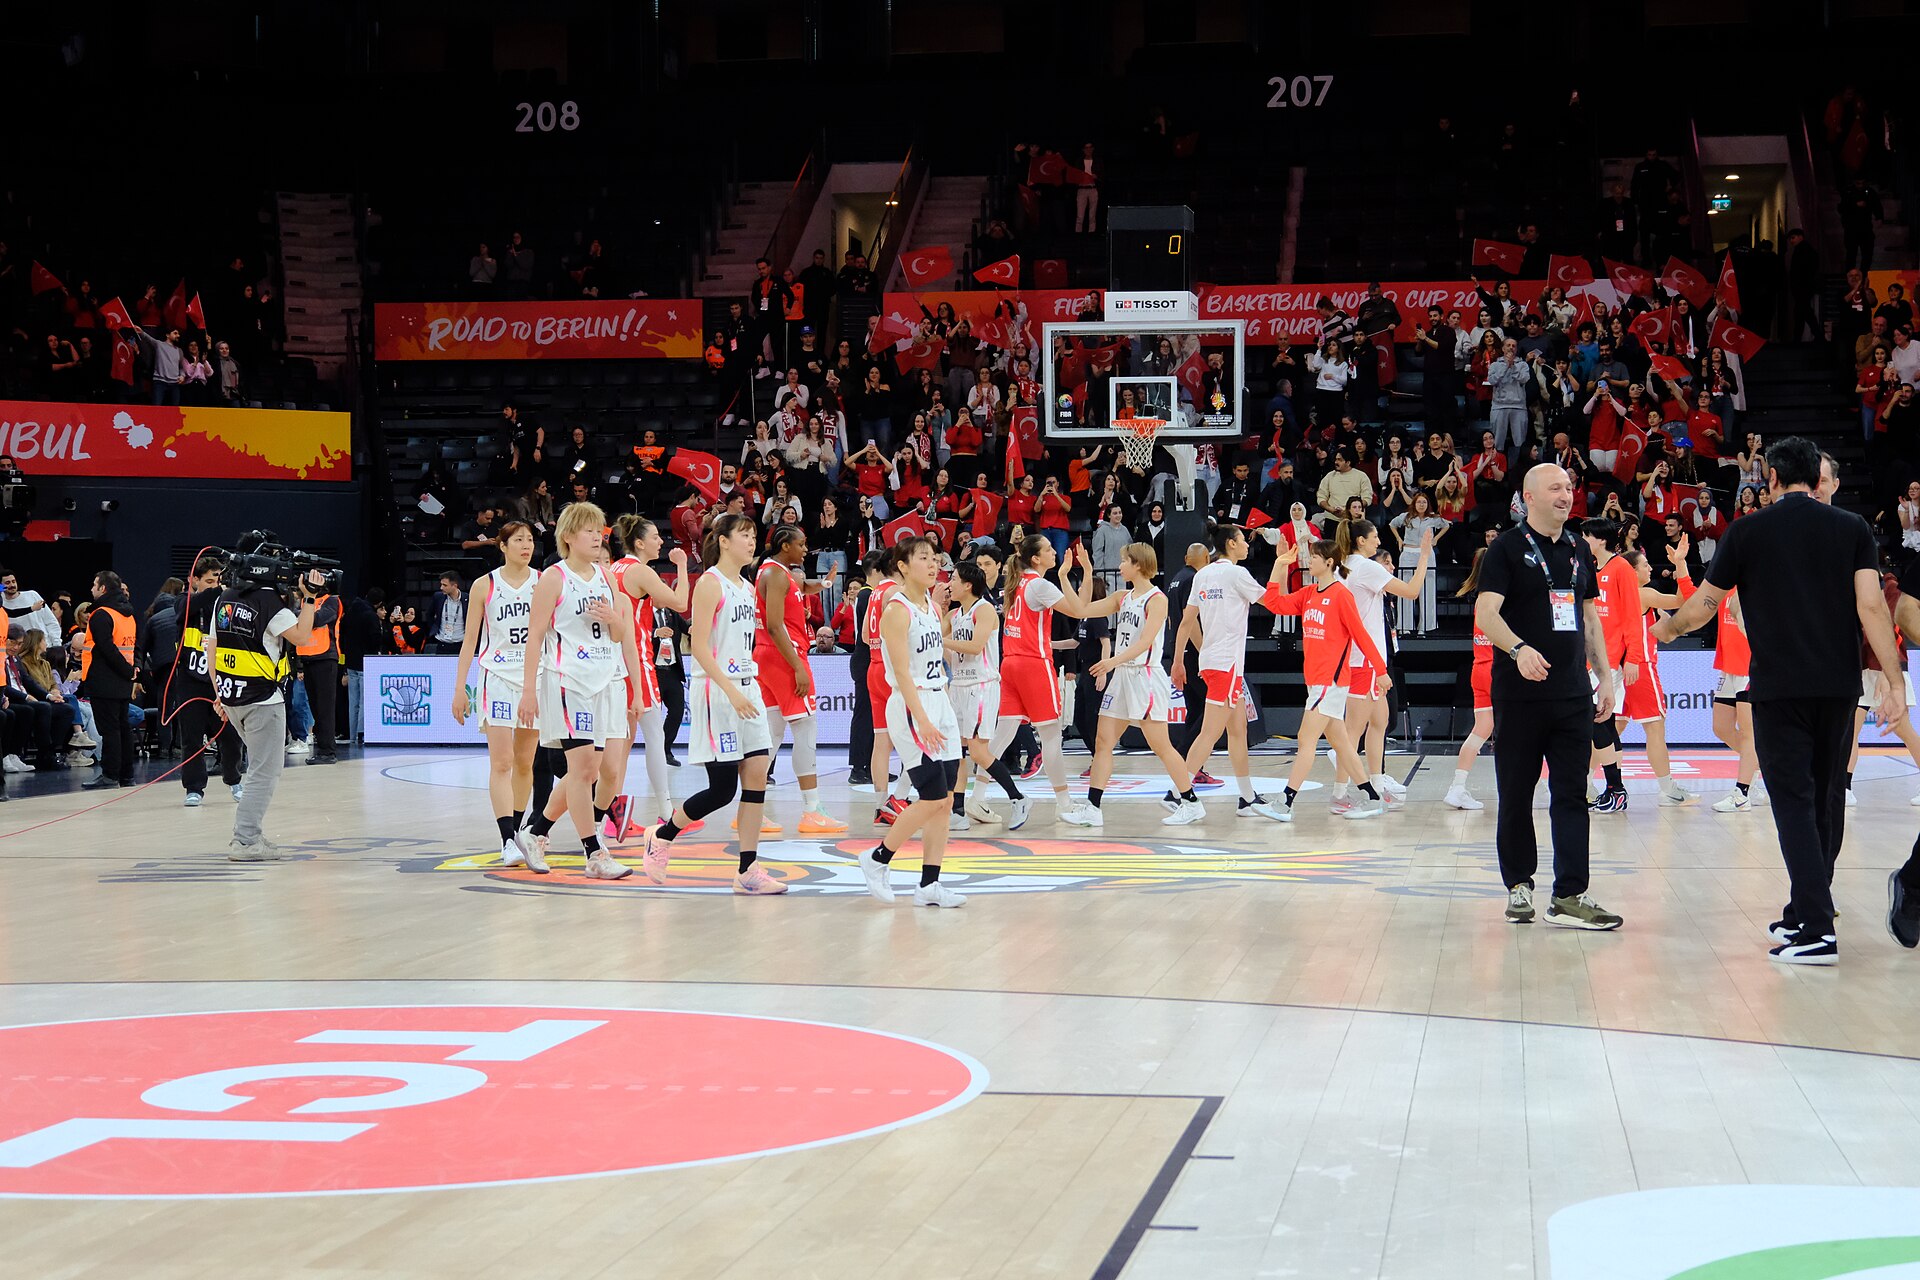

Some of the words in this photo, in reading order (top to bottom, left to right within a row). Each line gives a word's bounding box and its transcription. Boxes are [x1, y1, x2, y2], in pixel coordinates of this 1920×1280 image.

[1266, 75, 1334, 108] 207
[515, 100, 581, 132] 208
[1054, 296, 1085, 316] FIB
[1207, 289, 1320, 313] BASKETBALL
[1405, 290, 1449, 308] CUP
[1453, 291, 1489, 308] 20
[1134, 300, 1178, 309] TISSOT
[428, 316, 507, 351] ROAD
[510, 321, 532, 340] TO
[535, 308, 648, 345] BERLIN!!
[235, 607, 252, 622] FIBA
[496, 602, 531, 622] JAPA
[731, 604, 754, 623] JAPA
[870, 606, 877, 633] 6
[509, 627, 529, 644] 52
[591, 622, 601, 639] 8
[1120, 631, 1130, 647] 75
[916, 631, 943, 653] JAPA
[224, 654, 236, 669] HB
[815, 692, 855, 711] rant
[1664, 689, 1716, 710] rant
[0, 1020, 610, 1169] TCL
